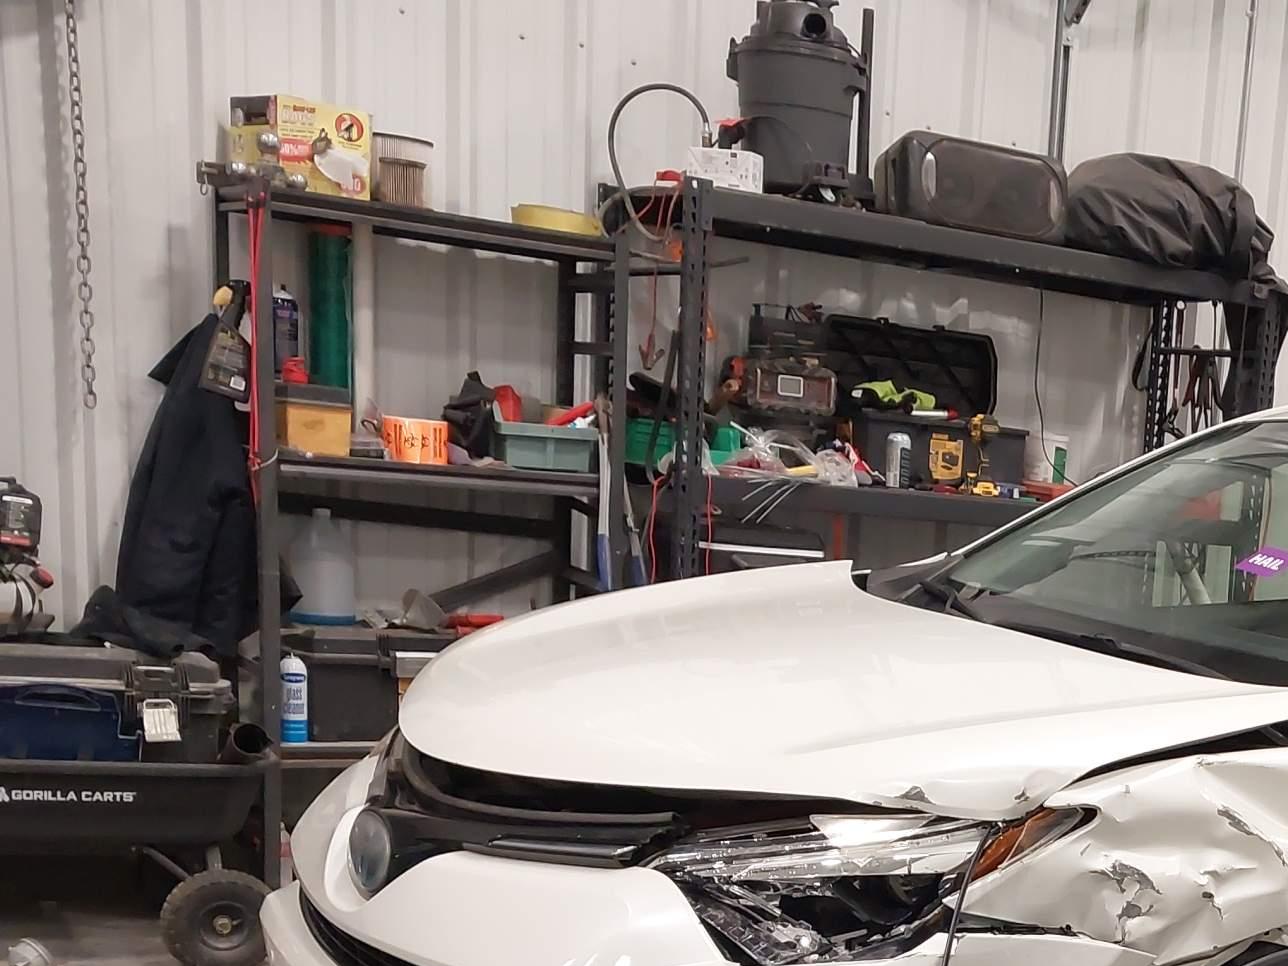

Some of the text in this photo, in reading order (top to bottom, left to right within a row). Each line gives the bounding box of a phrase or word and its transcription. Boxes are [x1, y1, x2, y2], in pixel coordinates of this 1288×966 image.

[1248, 553, 1284, 571] HAIL
[11, 789, 134, 803] GORILLA CARTS
